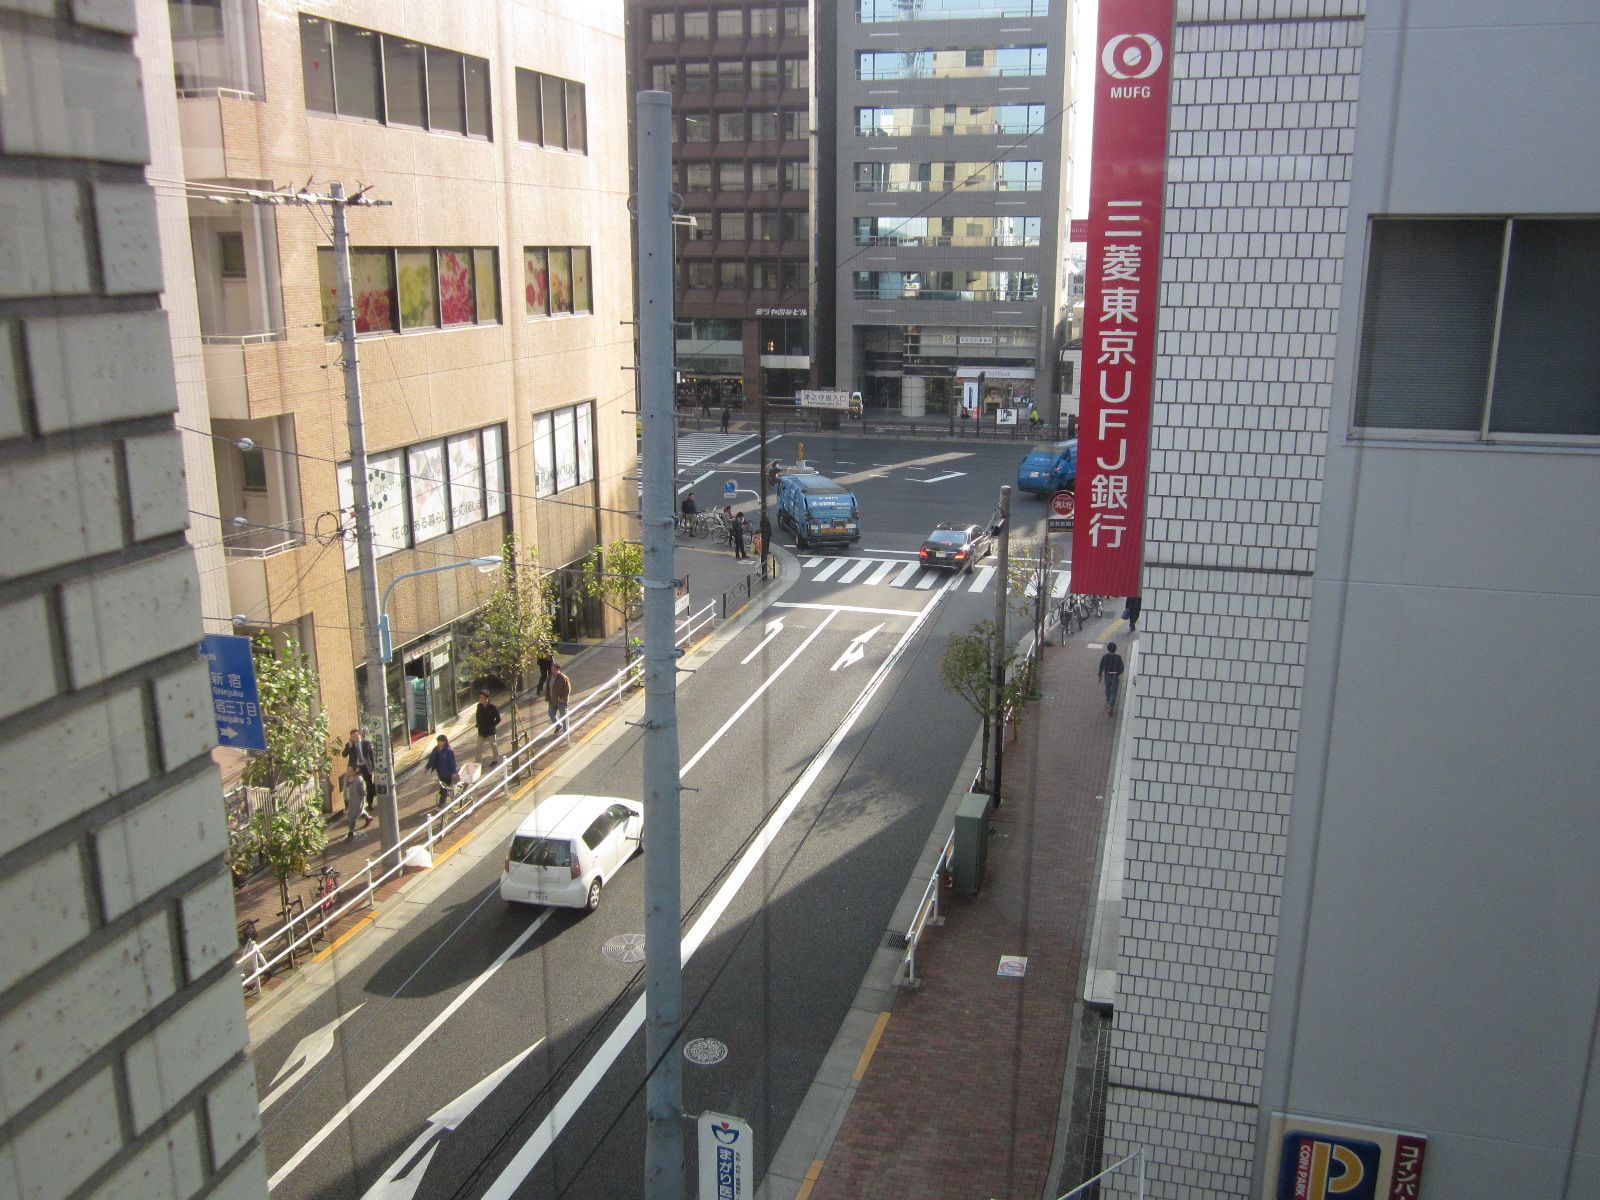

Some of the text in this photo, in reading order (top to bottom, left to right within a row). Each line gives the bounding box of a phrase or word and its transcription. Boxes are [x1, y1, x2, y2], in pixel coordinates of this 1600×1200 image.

[1110, 86, 1151, 99] MUFG
[1088, 200, 1143, 549] 三菱東京UFJ銀行
[215, 699, 257, 717] 宿三丁目
[246, 717, 252, 725] 3
[1295, 1144, 1311, 1197] COIN PARK
[1396, 1145, 1419, 1200] コインパ
